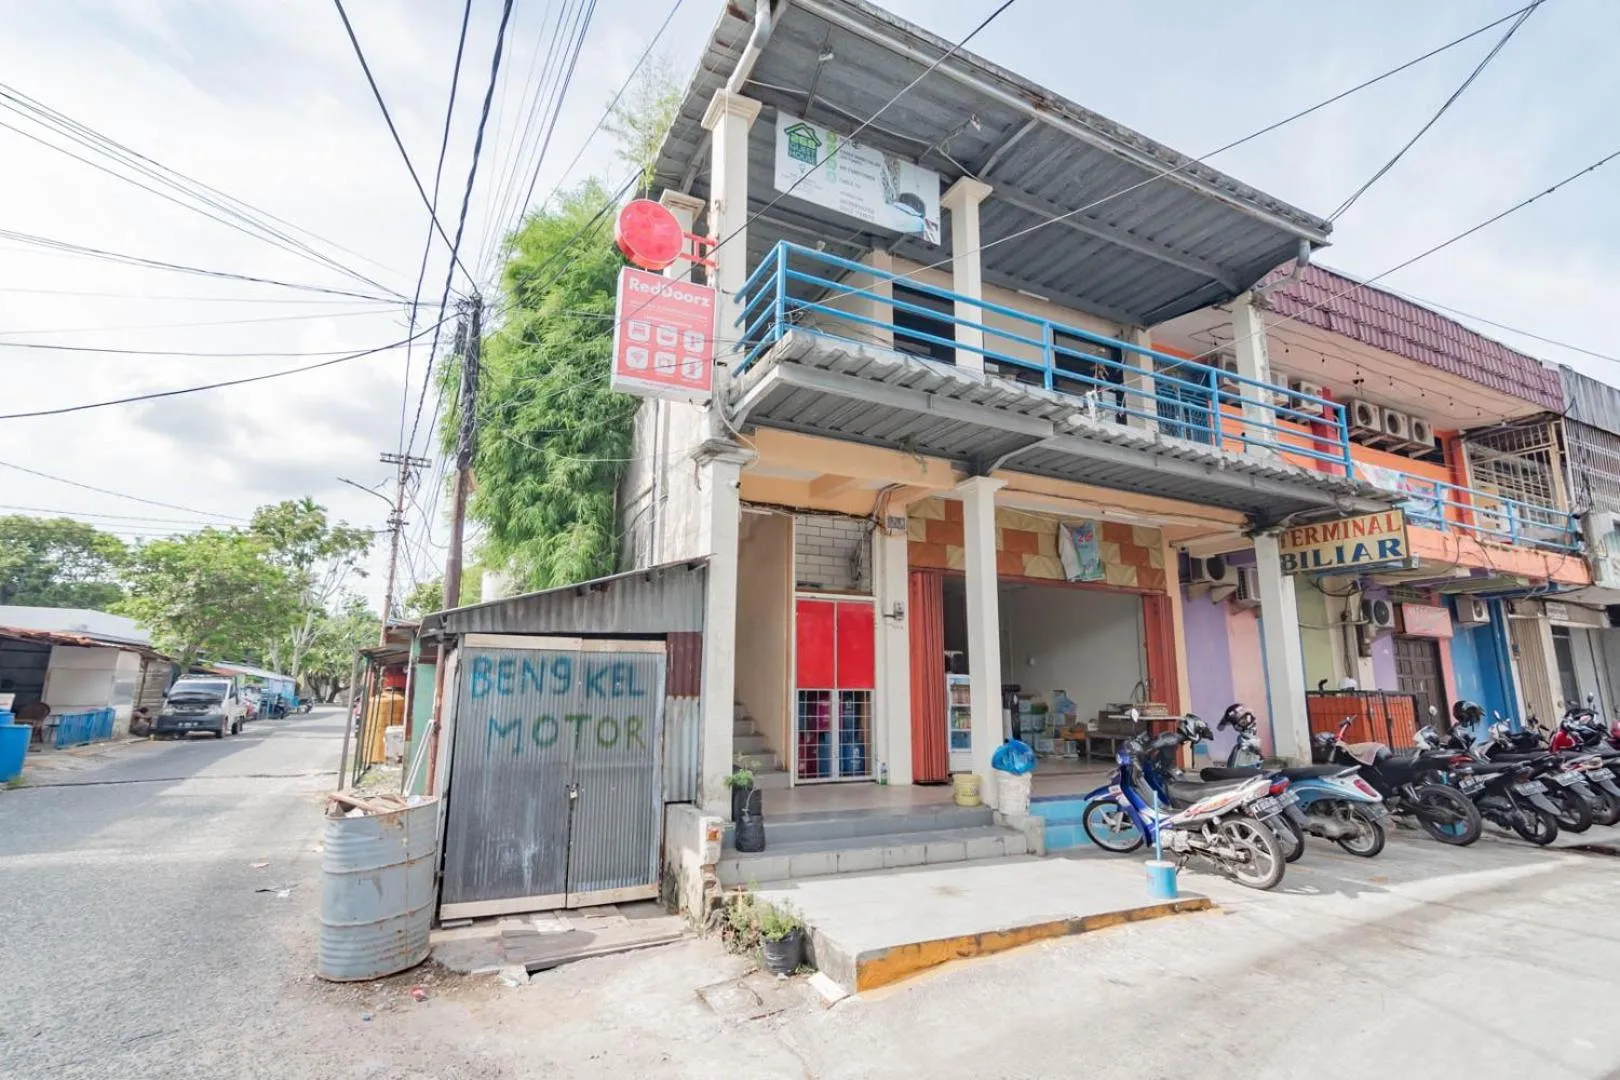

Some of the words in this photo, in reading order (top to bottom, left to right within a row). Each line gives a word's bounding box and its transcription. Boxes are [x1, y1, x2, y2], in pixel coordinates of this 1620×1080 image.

[628, 276, 710, 307] RedDoorz
[1280, 512, 1402, 549] TERMINAL
[1281, 538, 1403, 571] BILIAR
[486, 711, 646, 760] MOTOR
